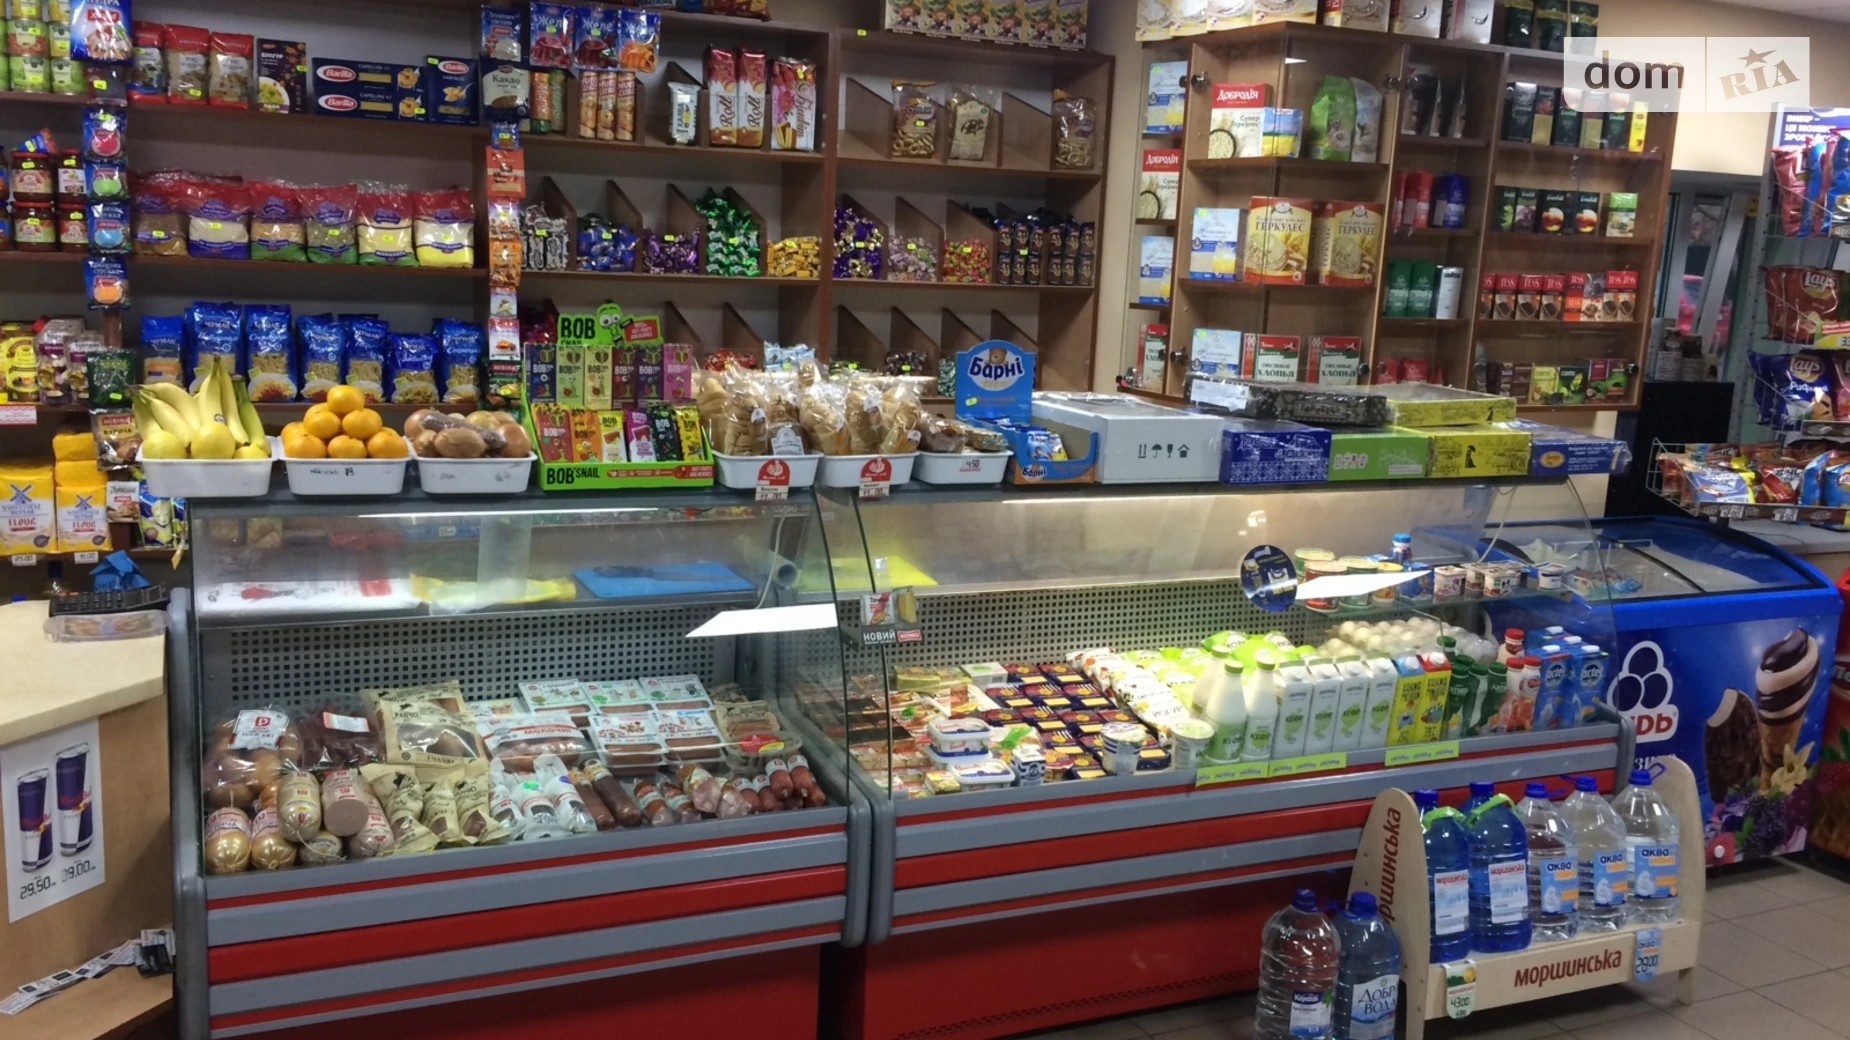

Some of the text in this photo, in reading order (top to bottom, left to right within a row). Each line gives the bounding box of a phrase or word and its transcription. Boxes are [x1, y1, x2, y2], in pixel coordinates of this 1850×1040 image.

[325, 69, 353, 80] Barilla
[492, 74, 521, 85] Какао
[327, 98, 355, 109] Barilla
[1500, 278, 1516, 287] TESS
[1524, 278, 1540, 287] TESS
[1547, 279, 1562, 288] TESS
[1571, 275, 1584, 284] TESS
[1608, 275, 1621, 284] TESS
[1622, 275, 1636, 284] TESS
[561, 317, 596, 339] BOB
[969, 356, 1024, 381] Барні
[547, 467, 600, 485] BOB SNAIL
[863, 629, 896, 642] НОВИЙ
[1642, 848, 1670, 857] аква
[1599, 854, 1623, 864] аква
[1380, 807, 1402, 923] ршинська
[1547, 861, 1572, 872] аква
[1513, 949, 1622, 988] моршинська
[1357, 985, 1399, 1003] ДОБР
